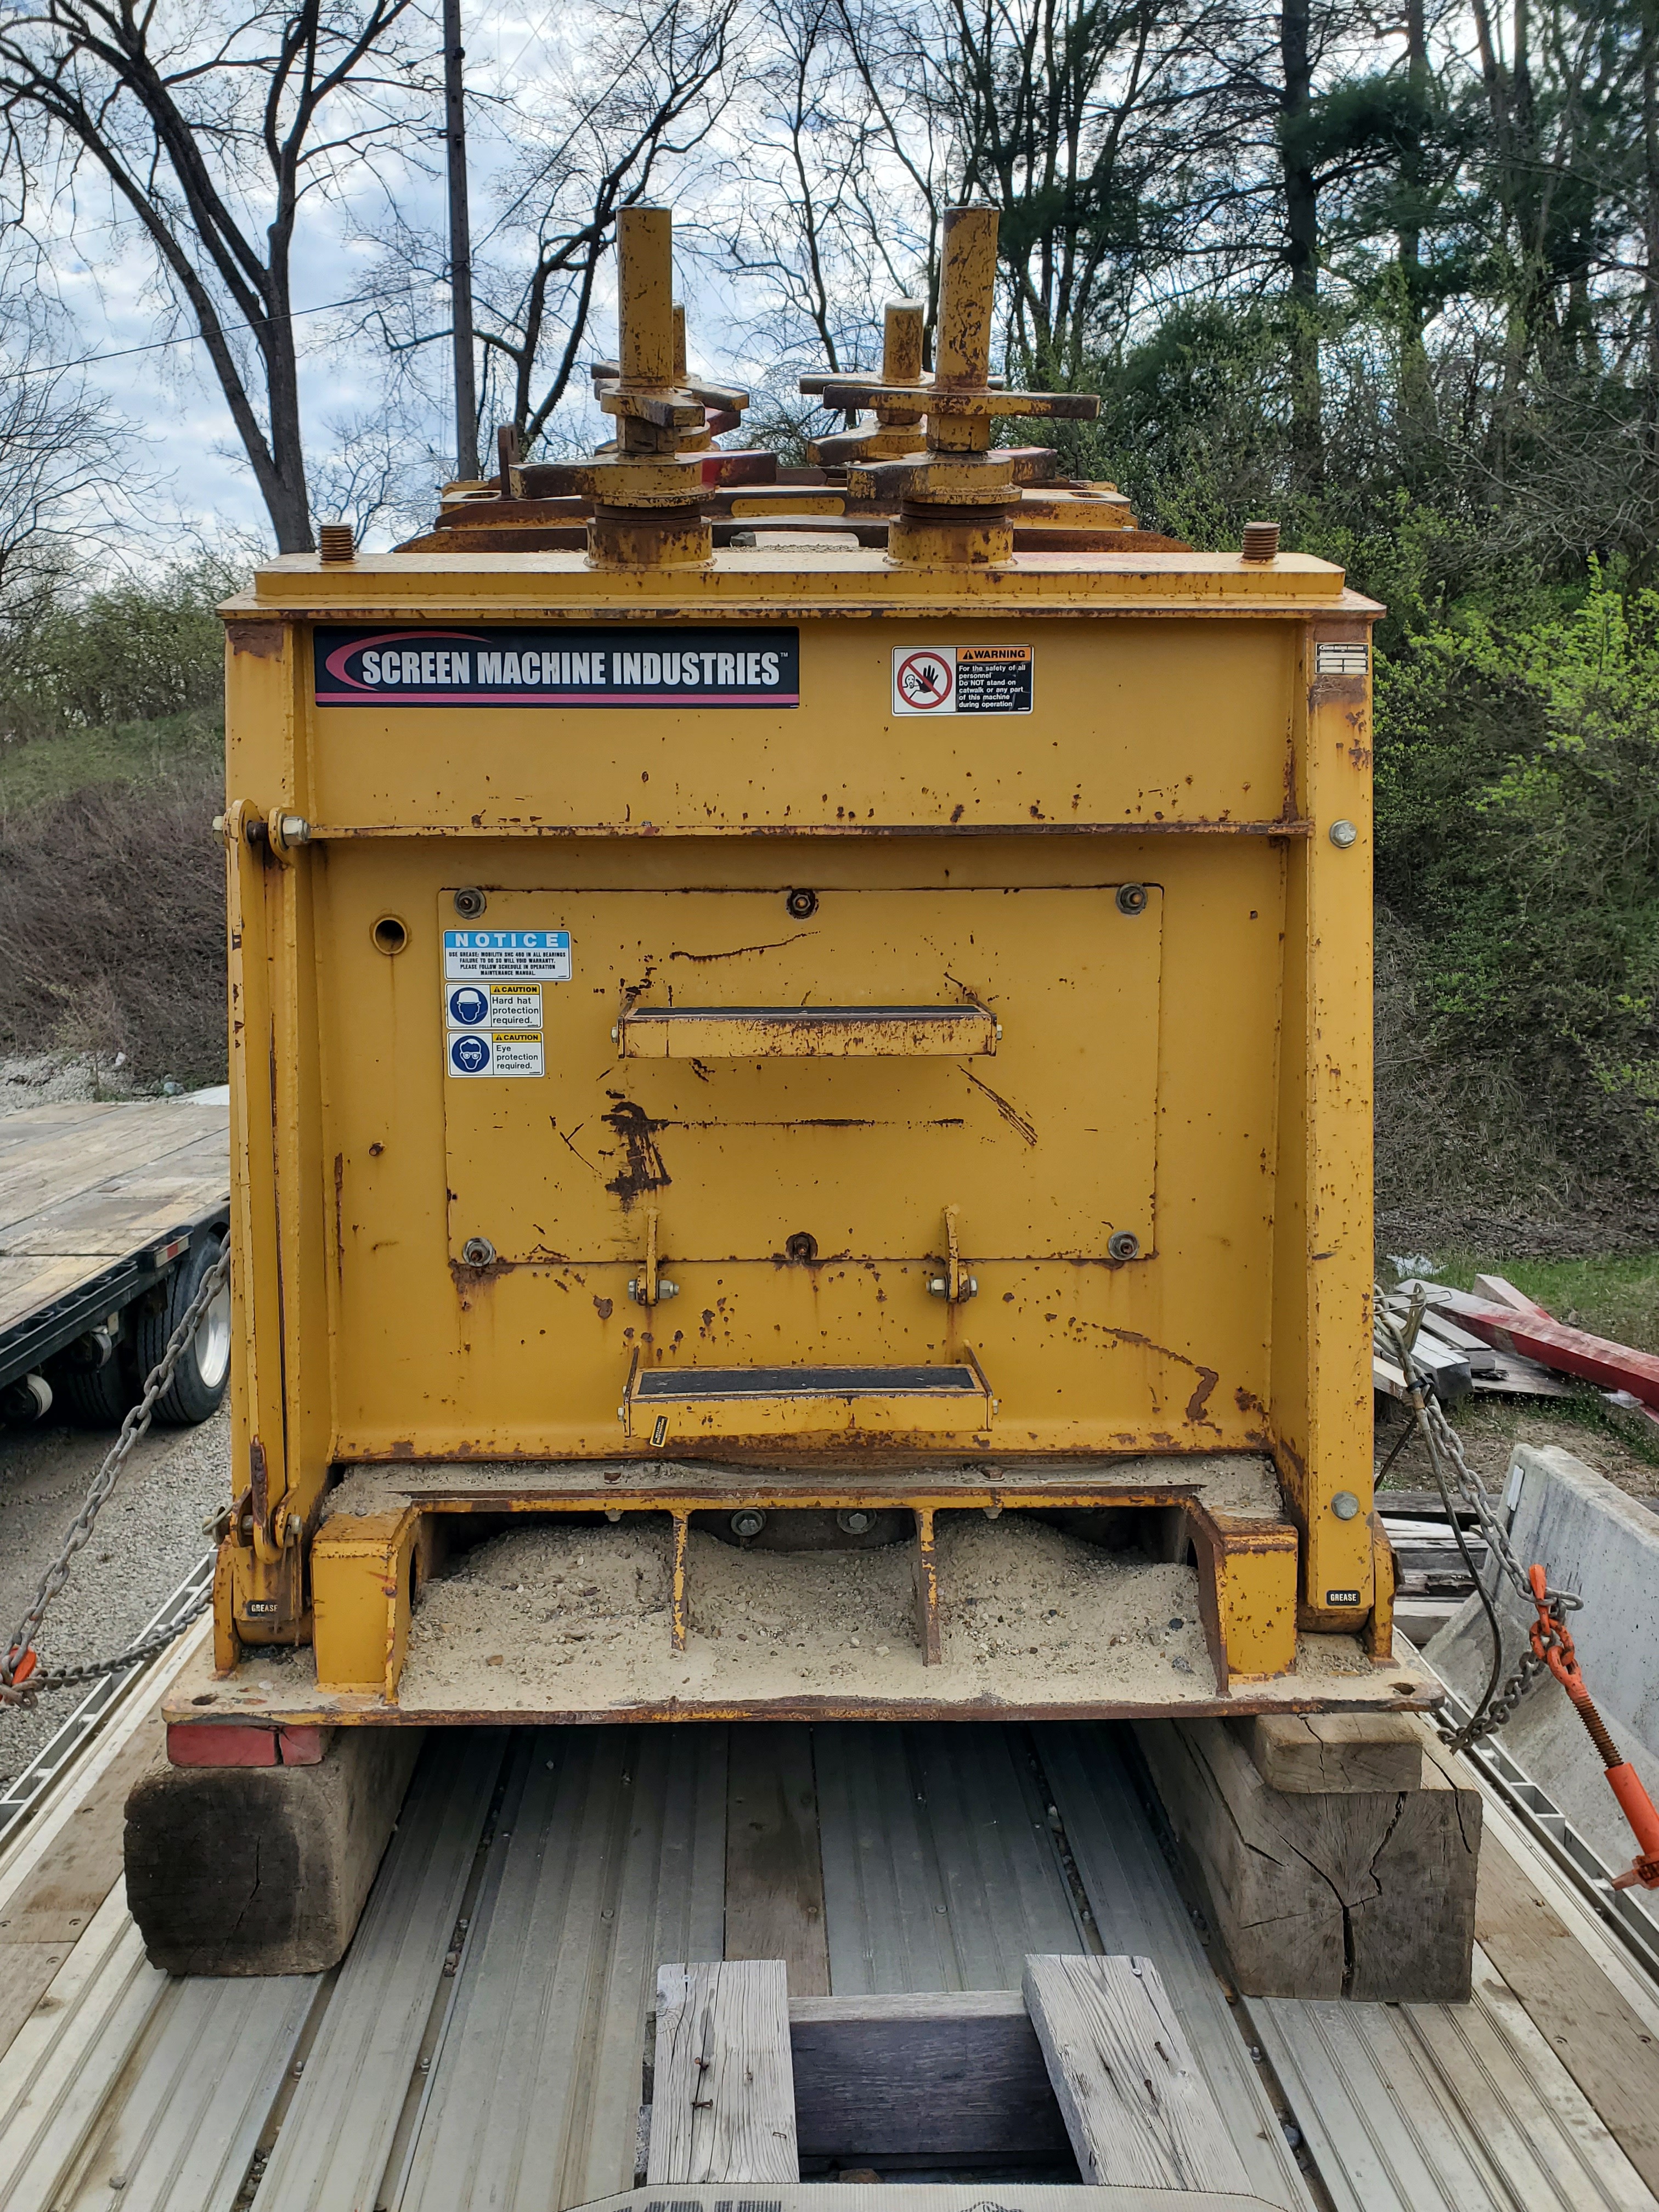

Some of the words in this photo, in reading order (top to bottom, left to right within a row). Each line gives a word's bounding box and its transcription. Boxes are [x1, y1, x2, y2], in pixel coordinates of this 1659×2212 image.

[974, 650, 1025, 658] WARNING
[362, 651, 470, 685] SCREEN
[477, 651, 607, 685] MACHINE
[455, 933, 558, 947] NOTICE
[493, 1007, 539, 1015] protection
[493, 1016, 532, 1025] required.
[496, 1053, 538, 1062] protection
